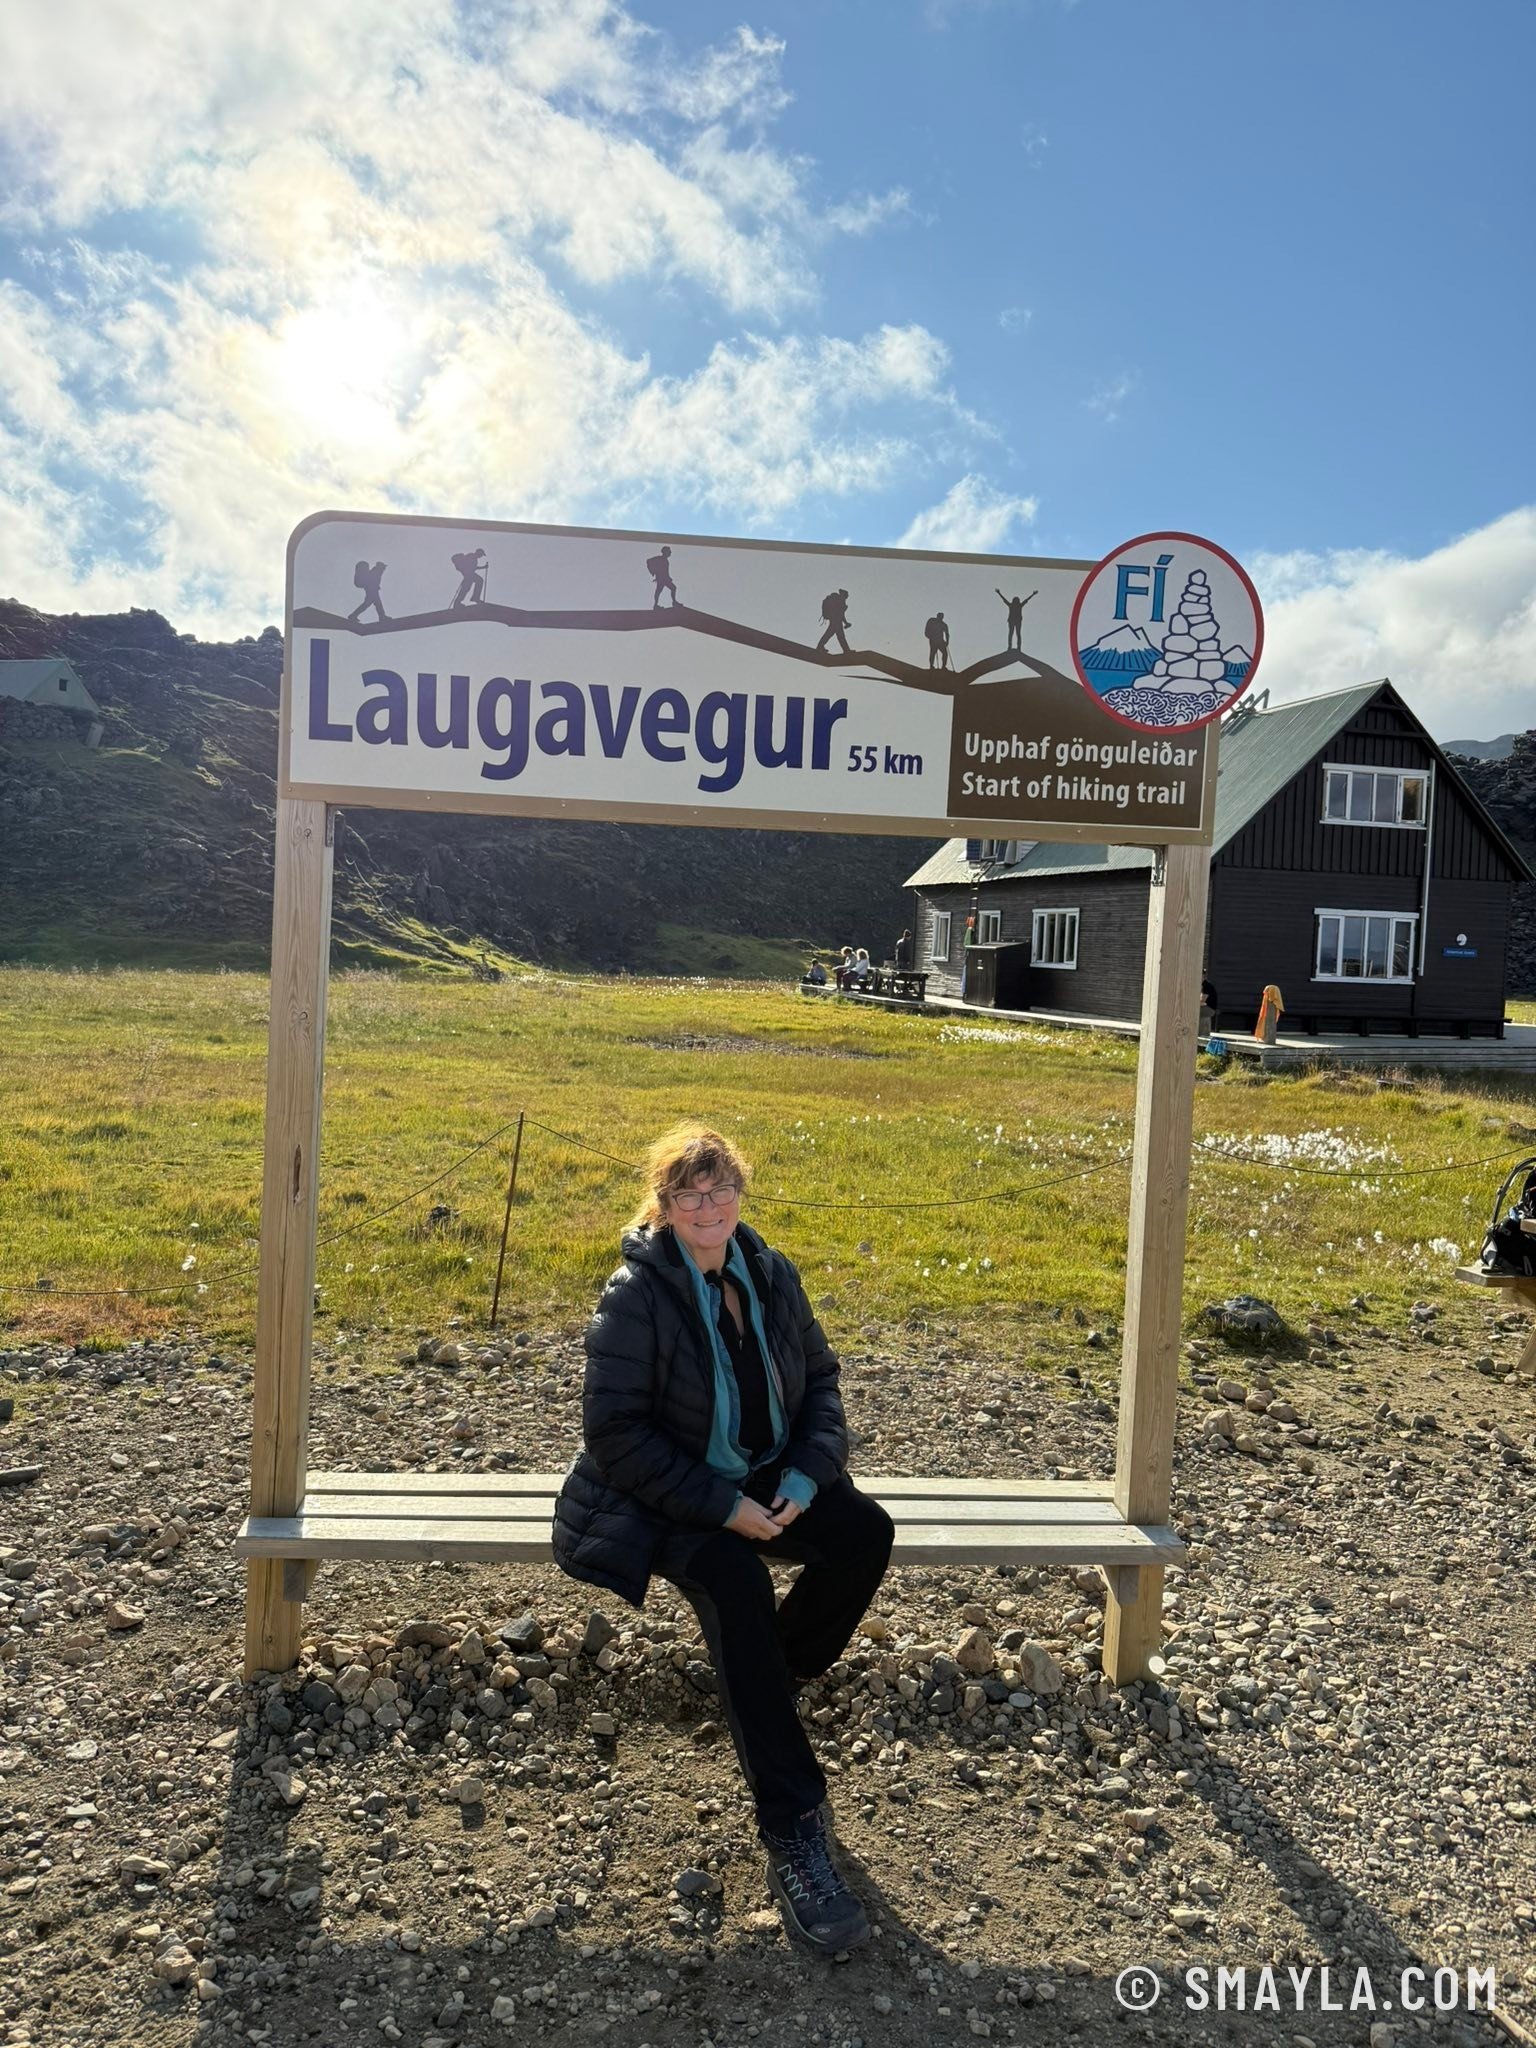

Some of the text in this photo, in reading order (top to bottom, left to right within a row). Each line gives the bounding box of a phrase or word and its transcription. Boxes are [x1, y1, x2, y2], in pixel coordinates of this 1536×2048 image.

[1112, 554, 1175, 623] FÍ
[308, 638, 924, 793] Laugavegur 55 km
[964, 732, 1198, 769] Upphaf gönguleiðar
[961, 772, 1186, 808] Start of hiking trail
